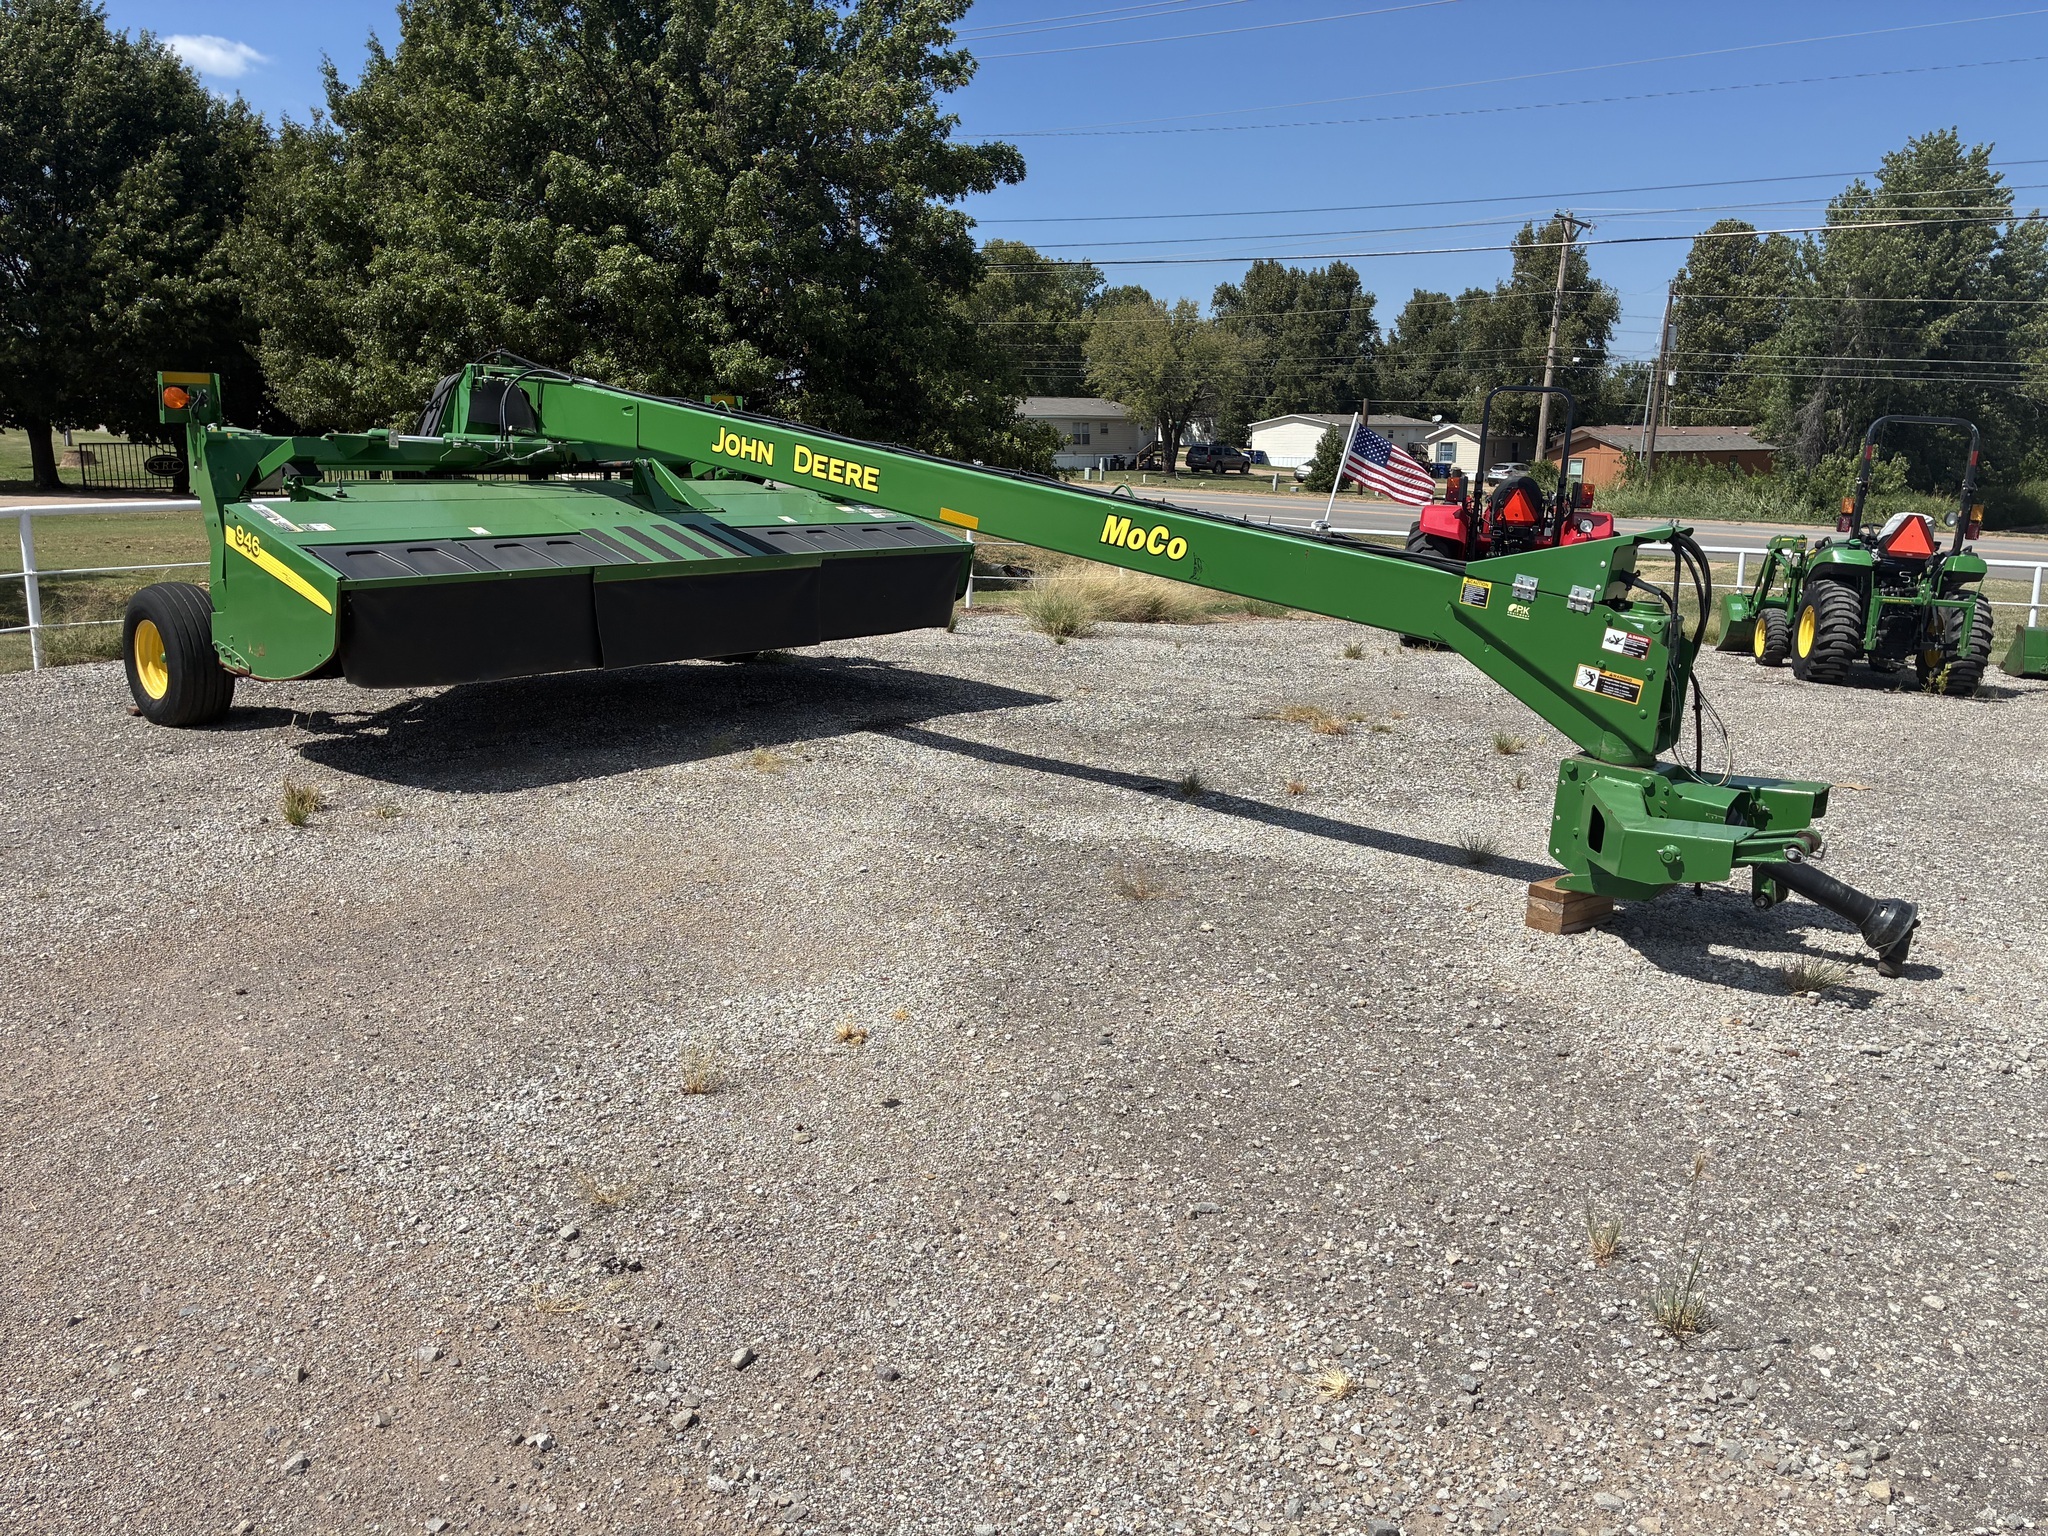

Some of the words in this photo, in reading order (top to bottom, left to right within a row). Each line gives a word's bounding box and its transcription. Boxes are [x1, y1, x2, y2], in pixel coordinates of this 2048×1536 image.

[711, 426, 774, 466] JOHN
[793, 443, 881, 493] DEERE
[235, 524, 260, 557] 946
[1099, 513, 1189, 561] MoCo
